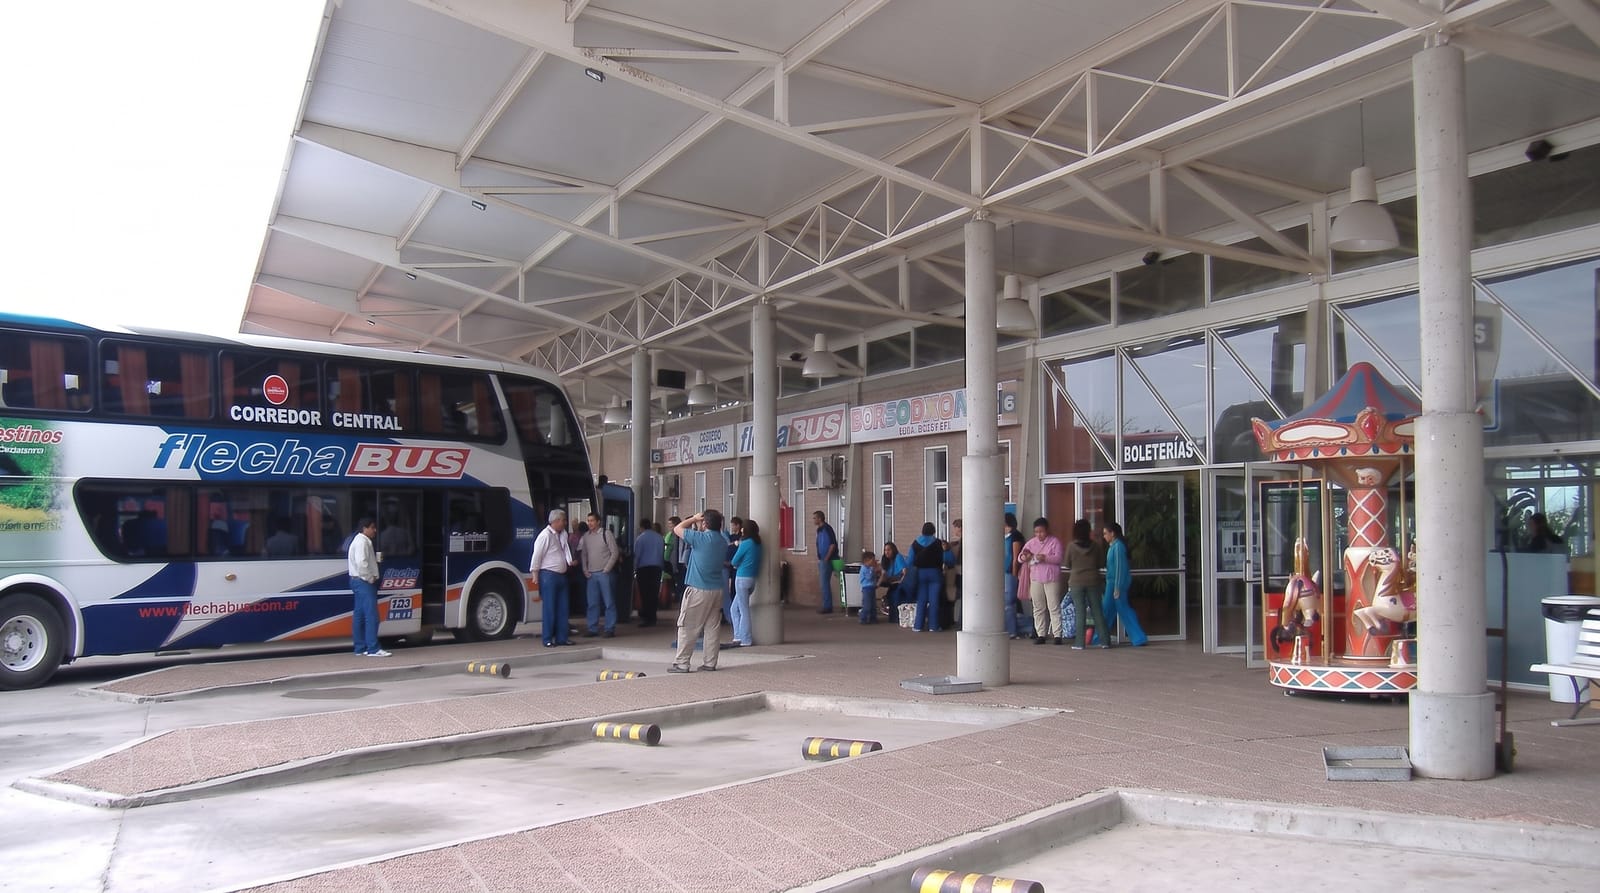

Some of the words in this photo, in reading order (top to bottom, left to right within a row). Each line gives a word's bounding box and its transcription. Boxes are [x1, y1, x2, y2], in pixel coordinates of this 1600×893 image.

[230, 405, 322, 426] CORREDOR
[332, 412, 403, 431] CENTRAL
[793, 413, 841, 443] BUS
[152, 433, 347, 476] flecha
[354, 447, 464, 474] BUS
[1123, 435, 1194, 463] BOLETERÍAS
[382, 578, 417, 588] BUS
[139, 600, 299, 618] www.flechabus.com.ar
